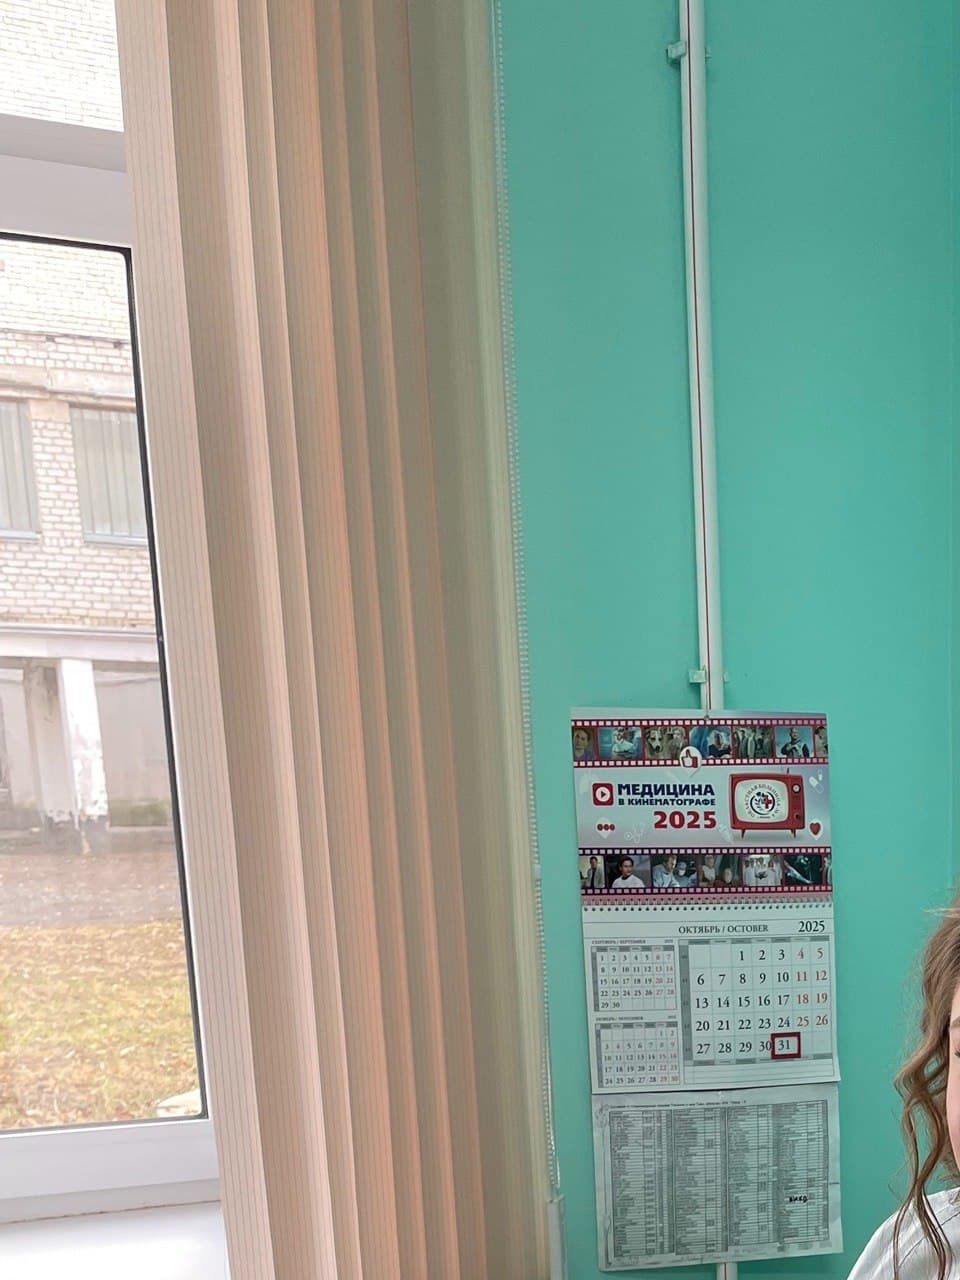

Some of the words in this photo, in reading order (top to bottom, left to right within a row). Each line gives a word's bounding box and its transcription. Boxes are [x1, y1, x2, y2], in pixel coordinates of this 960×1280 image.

[617, 783, 715, 798] МЕДИЦИНА
[627, 798, 716, 806] КИНЕМАТОГРАФЕ
[653, 810, 717, 829] 2025
[678, 925, 720, 934] ОКТЯБРЬ
[727, 924, 769, 933] OCTOBER
[798, 920, 825, 932] 2025
[739, 951, 744, 961] 1
[758, 950, 766, 961] 2
[778, 949, 785, 960] 3
[797, 948, 804, 960] 4
[817, 947, 823, 959] 5
[697, 974, 705, 985] 6
[718, 974, 726, 985] 7
[739, 973, 747, 984] 8
[759, 973, 766, 984] 9
[777, 972, 789, 983] 10
[796, 971, 807, 982] 11
[816, 970, 827, 981] 12
[695, 997, 709, 1009] 13
[717, 997, 730, 1008] 14
[738, 996, 750, 1007] 15
[758, 995, 771, 1006] 16
[778, 994, 790, 1006] 17
[797, 993, 809, 1004] 18
[816, 993, 828, 1004] 19
[695, 1020, 710, 1032] 20
[717, 1020, 730, 1031] 21
[738, 1019, 751, 1030] 22
[758, 1018, 771, 1029] 23
[777, 1017, 790, 1028] 24
[796, 1016, 809, 1027] 25
[815, 1015, 828, 1026] 26
[696, 1043, 711, 1054] 27
[718, 1042, 732, 1054] 28
[739, 1041, 752, 1053] 29
[759, 1040, 772, 1052] 30
[778, 1039, 790, 1051] 31
